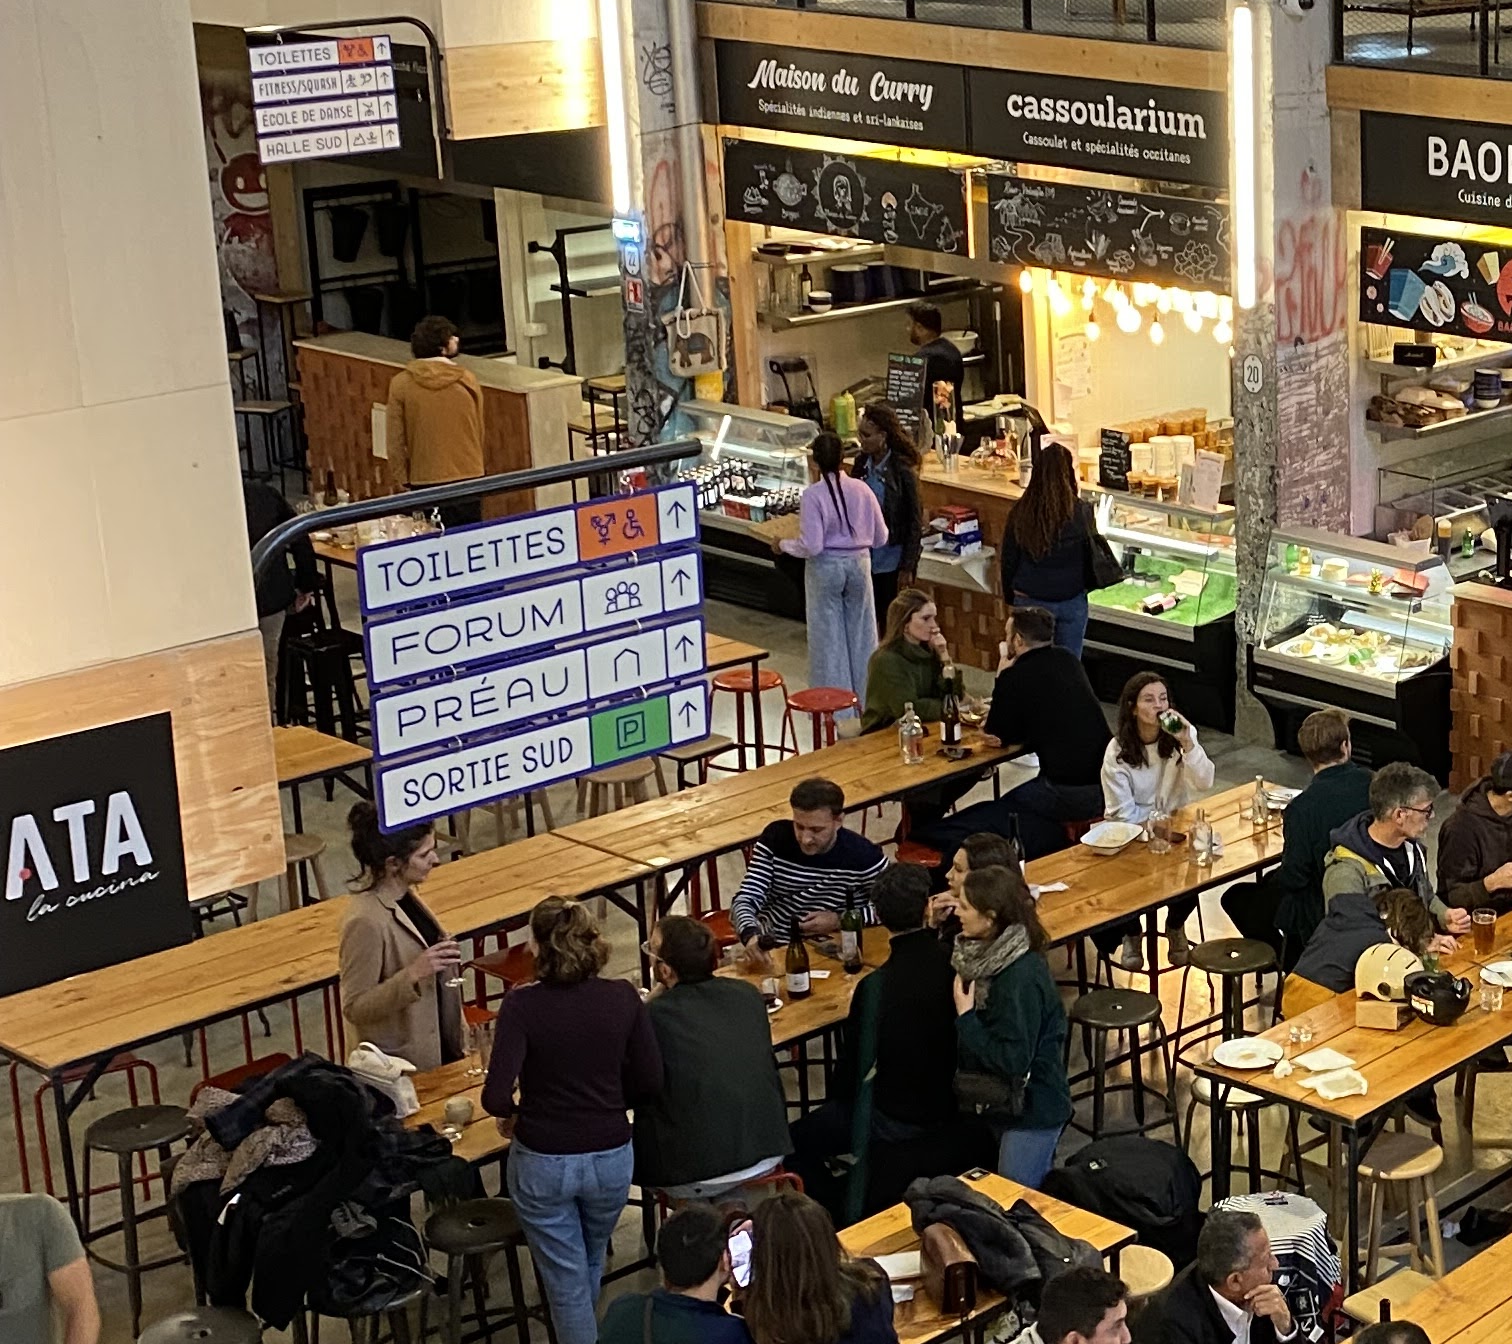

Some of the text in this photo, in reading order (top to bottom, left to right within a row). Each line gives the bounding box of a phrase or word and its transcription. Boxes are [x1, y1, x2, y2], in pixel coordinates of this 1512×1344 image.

[258, 47, 331, 67] TOILETTES
[259, 77, 338, 97] FITNESS/SQUASH
[747, 59, 934, 112] Maison du Curry
[262, 105, 354, 127] ÉCOLE DE DANSE
[758, 98, 924, 131] Spécialités indiennes et sri-lankaises
[1006, 93, 1207, 139] cassoularium
[266, 135, 343, 157] HALLE SUD
[1022, 131, 1191, 165] Cassoulet et spécialités occitanes
[1457, 189, 1501, 208] Cuisine
[1246, 365, 1259, 384] 20
[378, 527, 566, 592] TOILETTES
[392, 598, 564, 665] FORUM
[398, 667, 569, 737] PRÉAU
[403, 753, 510, 807] SORTIE
[522, 737, 574, 773] SUD
[26, 870, 161, 922] la cucina
